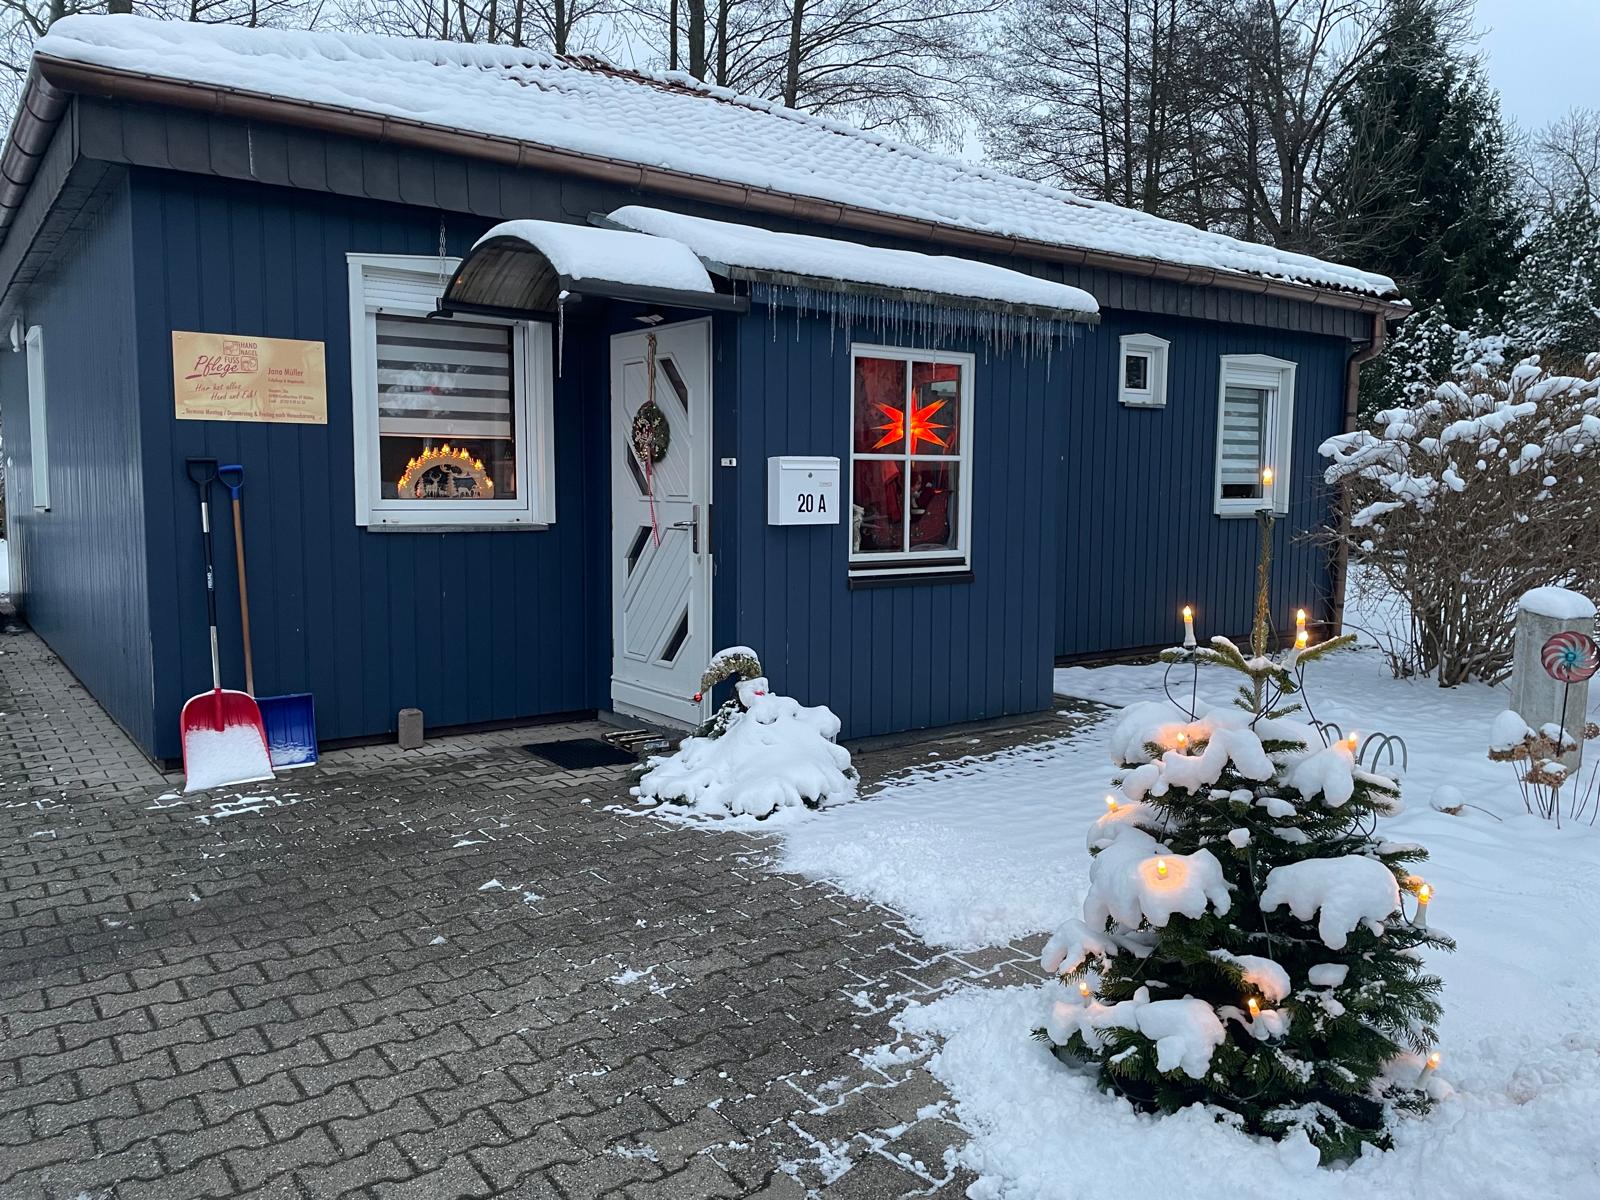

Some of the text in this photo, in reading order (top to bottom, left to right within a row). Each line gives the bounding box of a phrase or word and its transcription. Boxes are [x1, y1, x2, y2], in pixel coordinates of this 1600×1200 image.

[240, 341, 258, 349] HAND
[224, 356, 240, 364] FUSS
[194, 355, 239, 378] Pflege
[268, 367, 304, 377] Jana Müller
[211, 391, 228, 400] Hand
[797, 493, 827, 513] 20 A
